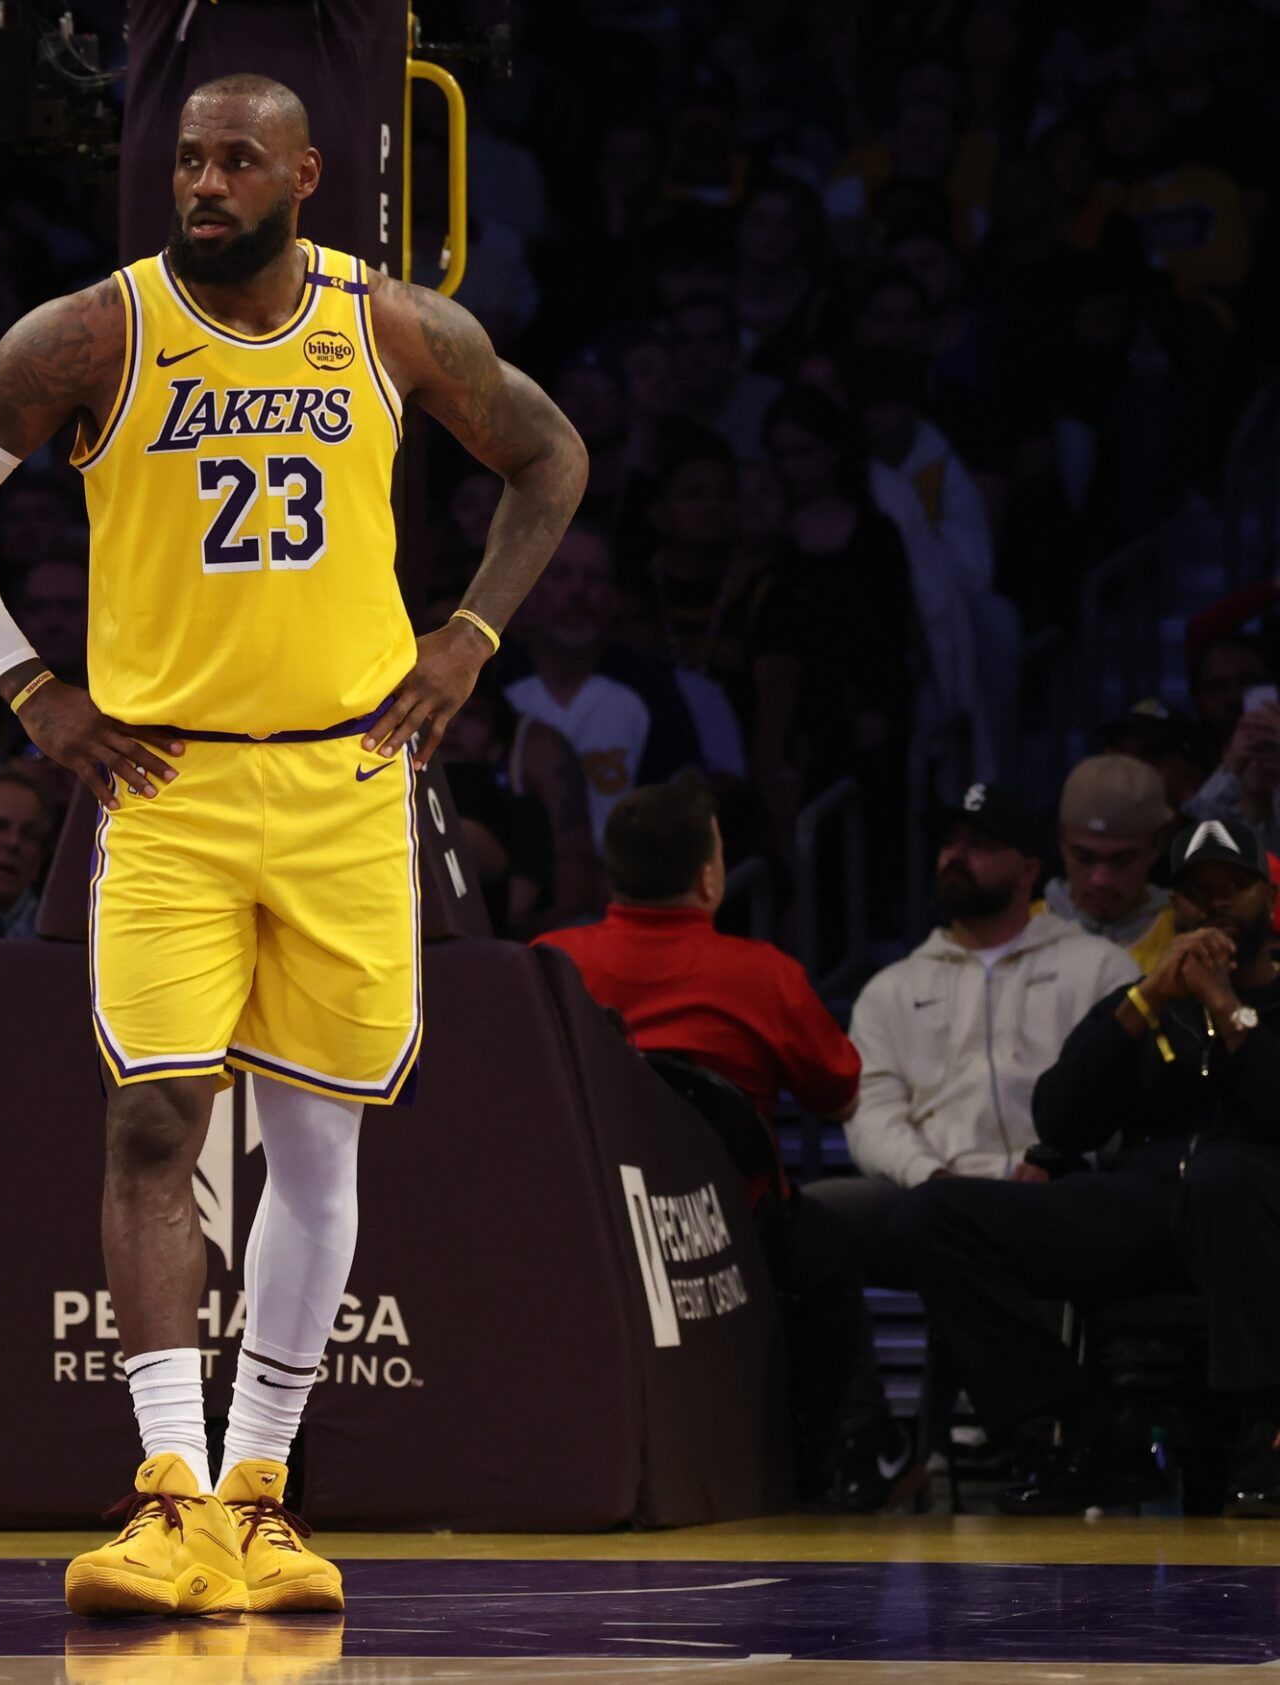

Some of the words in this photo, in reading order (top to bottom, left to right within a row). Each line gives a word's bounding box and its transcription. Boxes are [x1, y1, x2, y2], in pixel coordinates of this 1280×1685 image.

[330, 278, 345, 289] 44
[308, 341, 352, 360] bibigo
[145, 376, 354, 454] LAKERS
[197, 454, 327, 575] 23
[650, 1182, 732, 1262] PECHANGA
[54, 1290, 410, 1346] PEHAGA
[54, 1349, 221, 1382] REST
